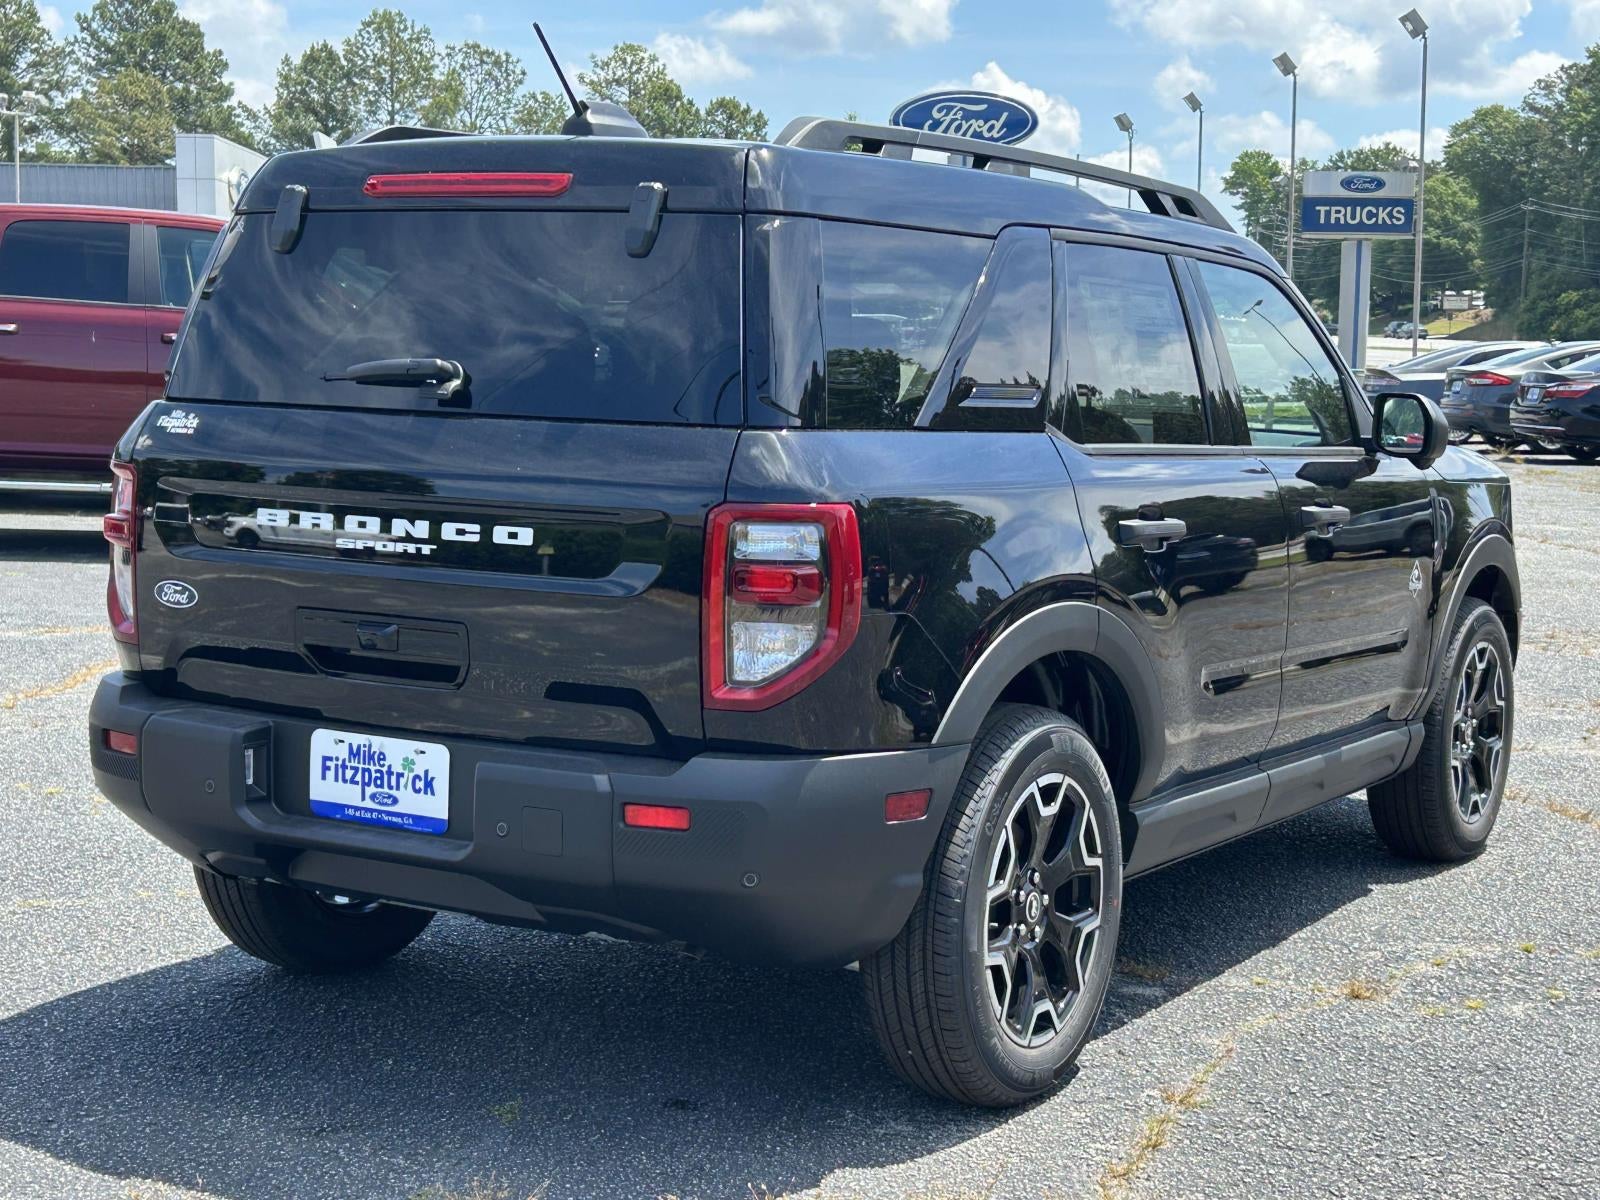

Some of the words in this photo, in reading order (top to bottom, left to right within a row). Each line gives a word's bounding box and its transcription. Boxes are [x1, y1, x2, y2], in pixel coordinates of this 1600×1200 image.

[923, 102, 1009, 138] Ford
[1350, 178, 1378, 190] Ford
[1315, 206, 1405, 225] TRUCKS
[256, 507, 534, 546] BRONCO
[335, 538, 437, 555] SPORT
[161, 584, 189, 604] Ford
[347, 742, 387, 769] Mike
[320, 755, 437, 802] Fitzpatrick
[374, 793, 394, 805] Ford
[403, 815, 413, 825] GA
